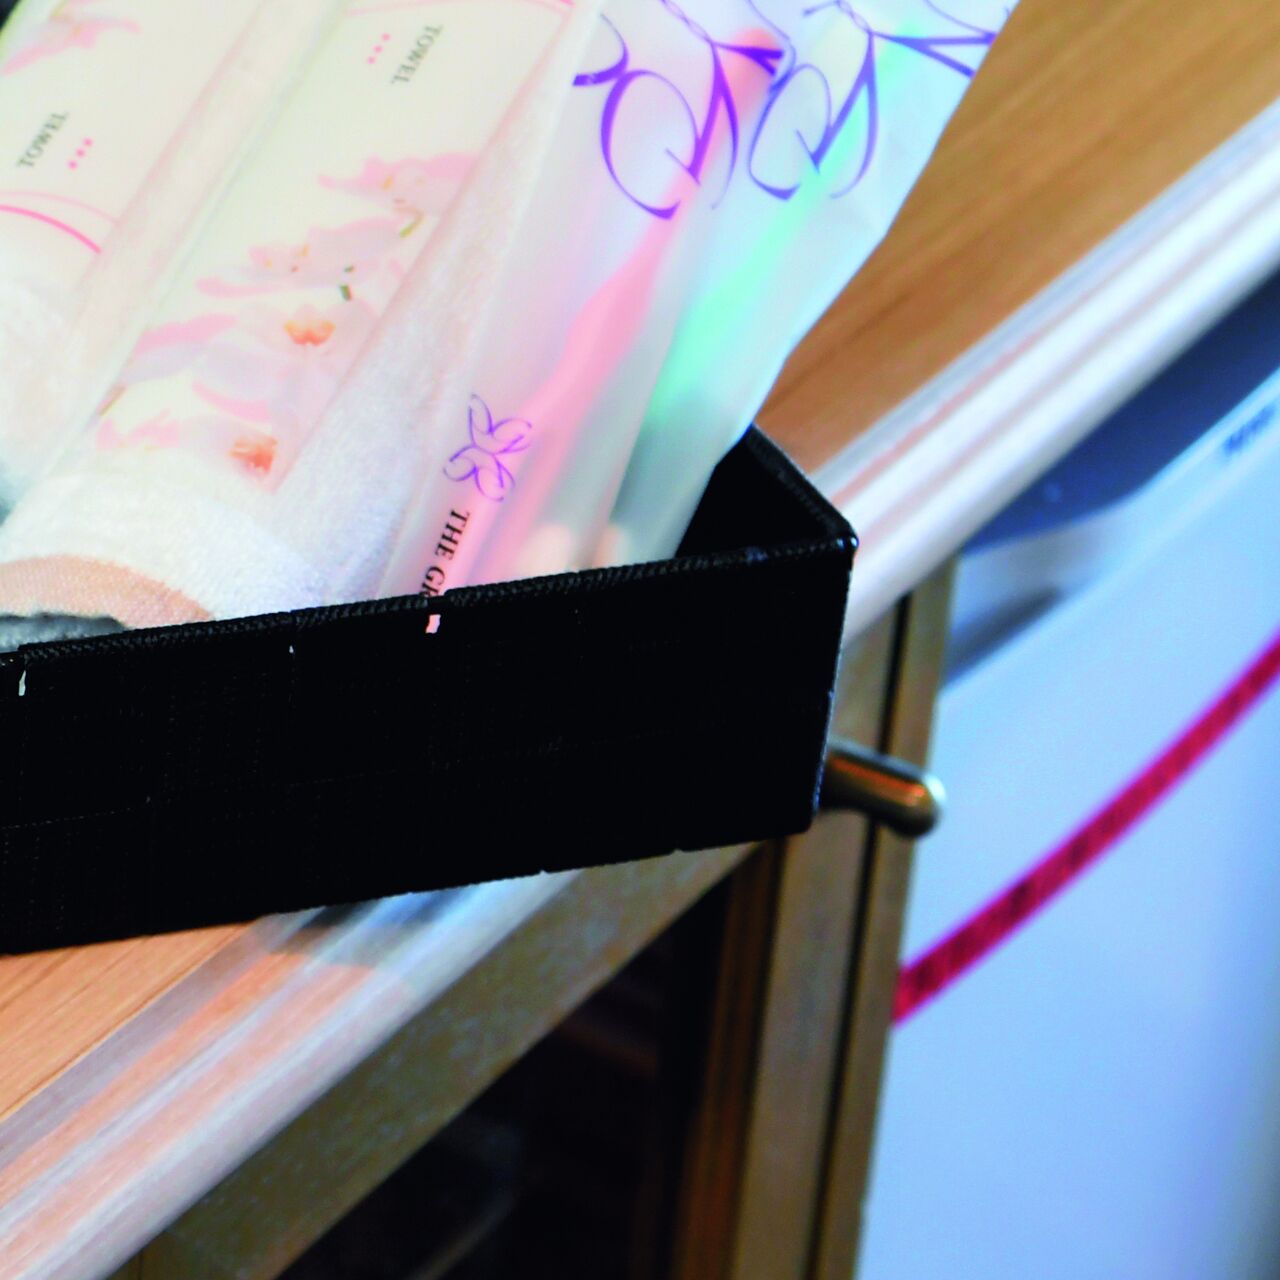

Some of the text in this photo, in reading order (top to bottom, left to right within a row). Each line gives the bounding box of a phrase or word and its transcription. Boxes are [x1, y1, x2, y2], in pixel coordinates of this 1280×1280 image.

[389, 23, 444, 84] TOWEL
[16, 111, 70, 169] TOWEL
[435, 509, 470, 561] THE
